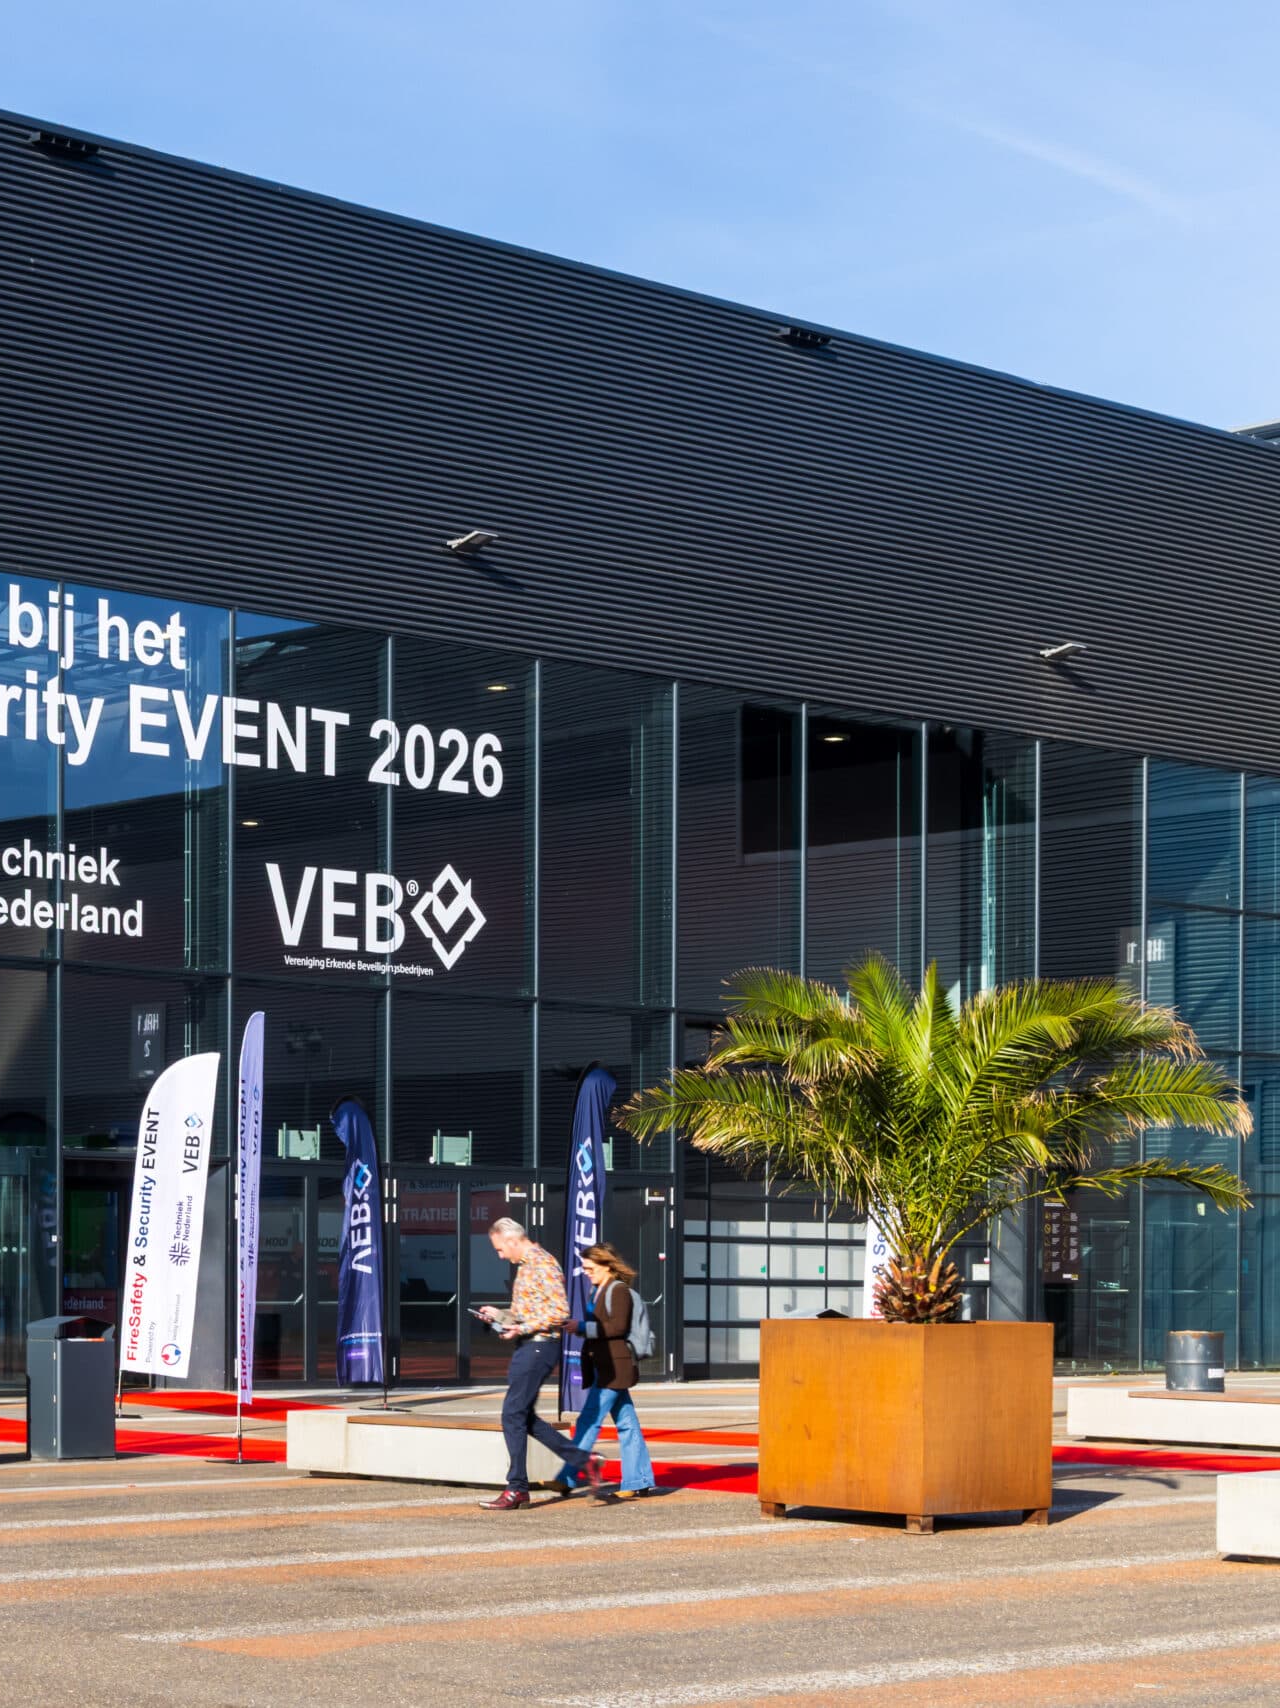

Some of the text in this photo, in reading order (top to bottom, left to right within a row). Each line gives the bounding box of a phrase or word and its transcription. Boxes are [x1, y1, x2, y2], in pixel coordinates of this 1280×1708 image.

[9, 583, 74, 668] bij
[99, 598, 186, 670] het
[129, 683, 350, 777] EVENT
[368, 719, 504, 798] 2026
[284, 954, 325, 970] Vereniging
[325, 958, 356, 970] Erkende
[182, 1135, 201, 1174] VEB
[126, 1107, 160, 1361] FireSafety & Security EVENT
[173, 1200, 184, 1241] Techniek
[182, 1195, 193, 1241] Nederland
